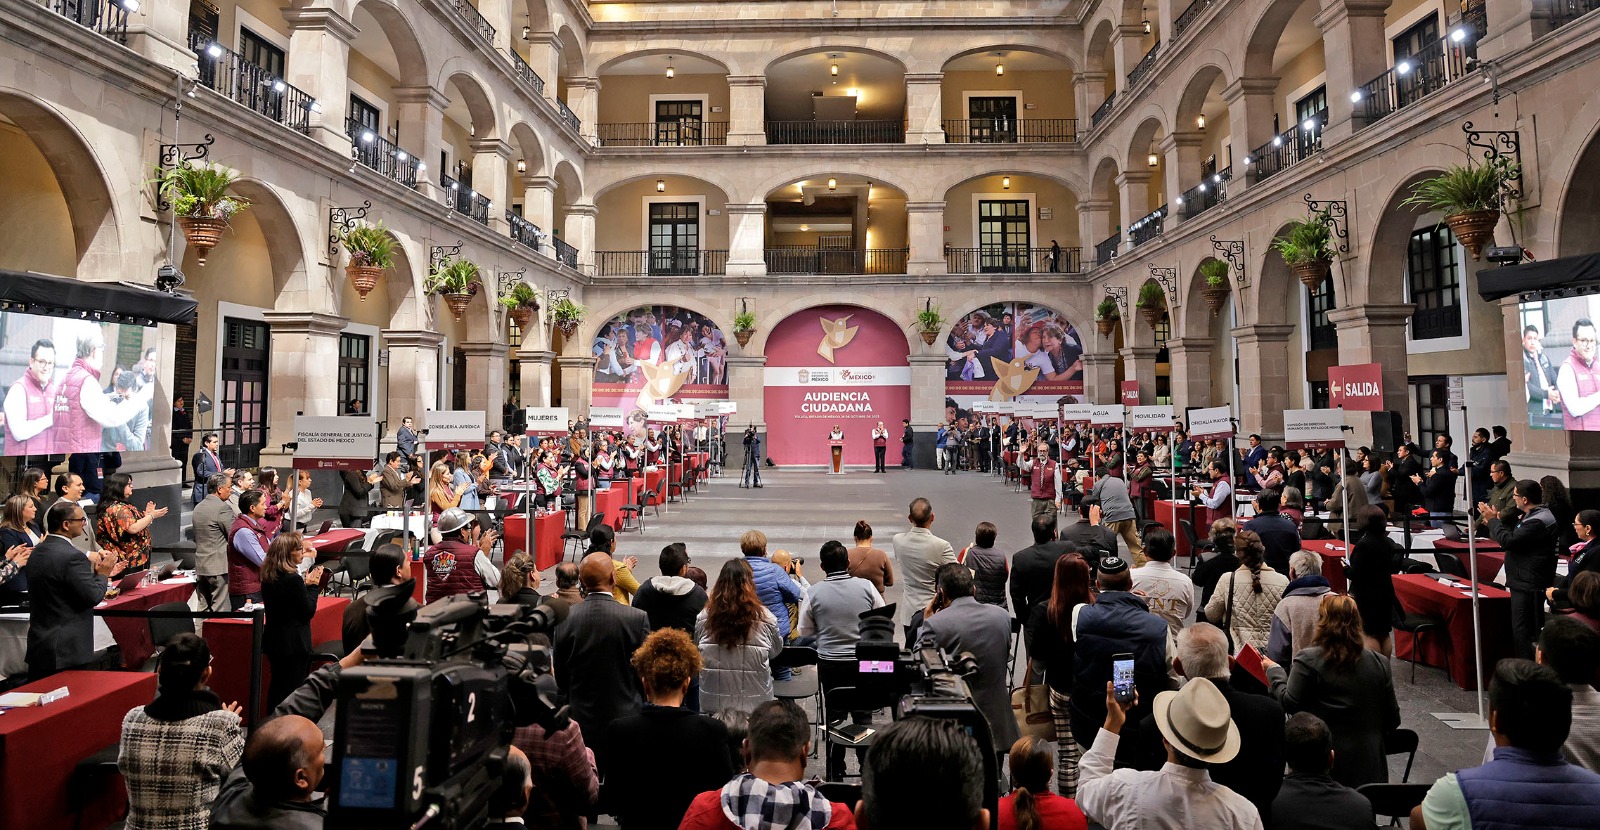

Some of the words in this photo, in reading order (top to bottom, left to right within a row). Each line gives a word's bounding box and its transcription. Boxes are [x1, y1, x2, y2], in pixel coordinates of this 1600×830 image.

[1126, 390, 1138, 398] SALIDA
[1346, 382, 1380, 396] SALIDA
[804, 392, 870, 401] AUDIENCIA
[801, 403, 872, 412] CIUDADANA
[468, 692, 476, 722] 2
[412, 766, 423, 800] 5
